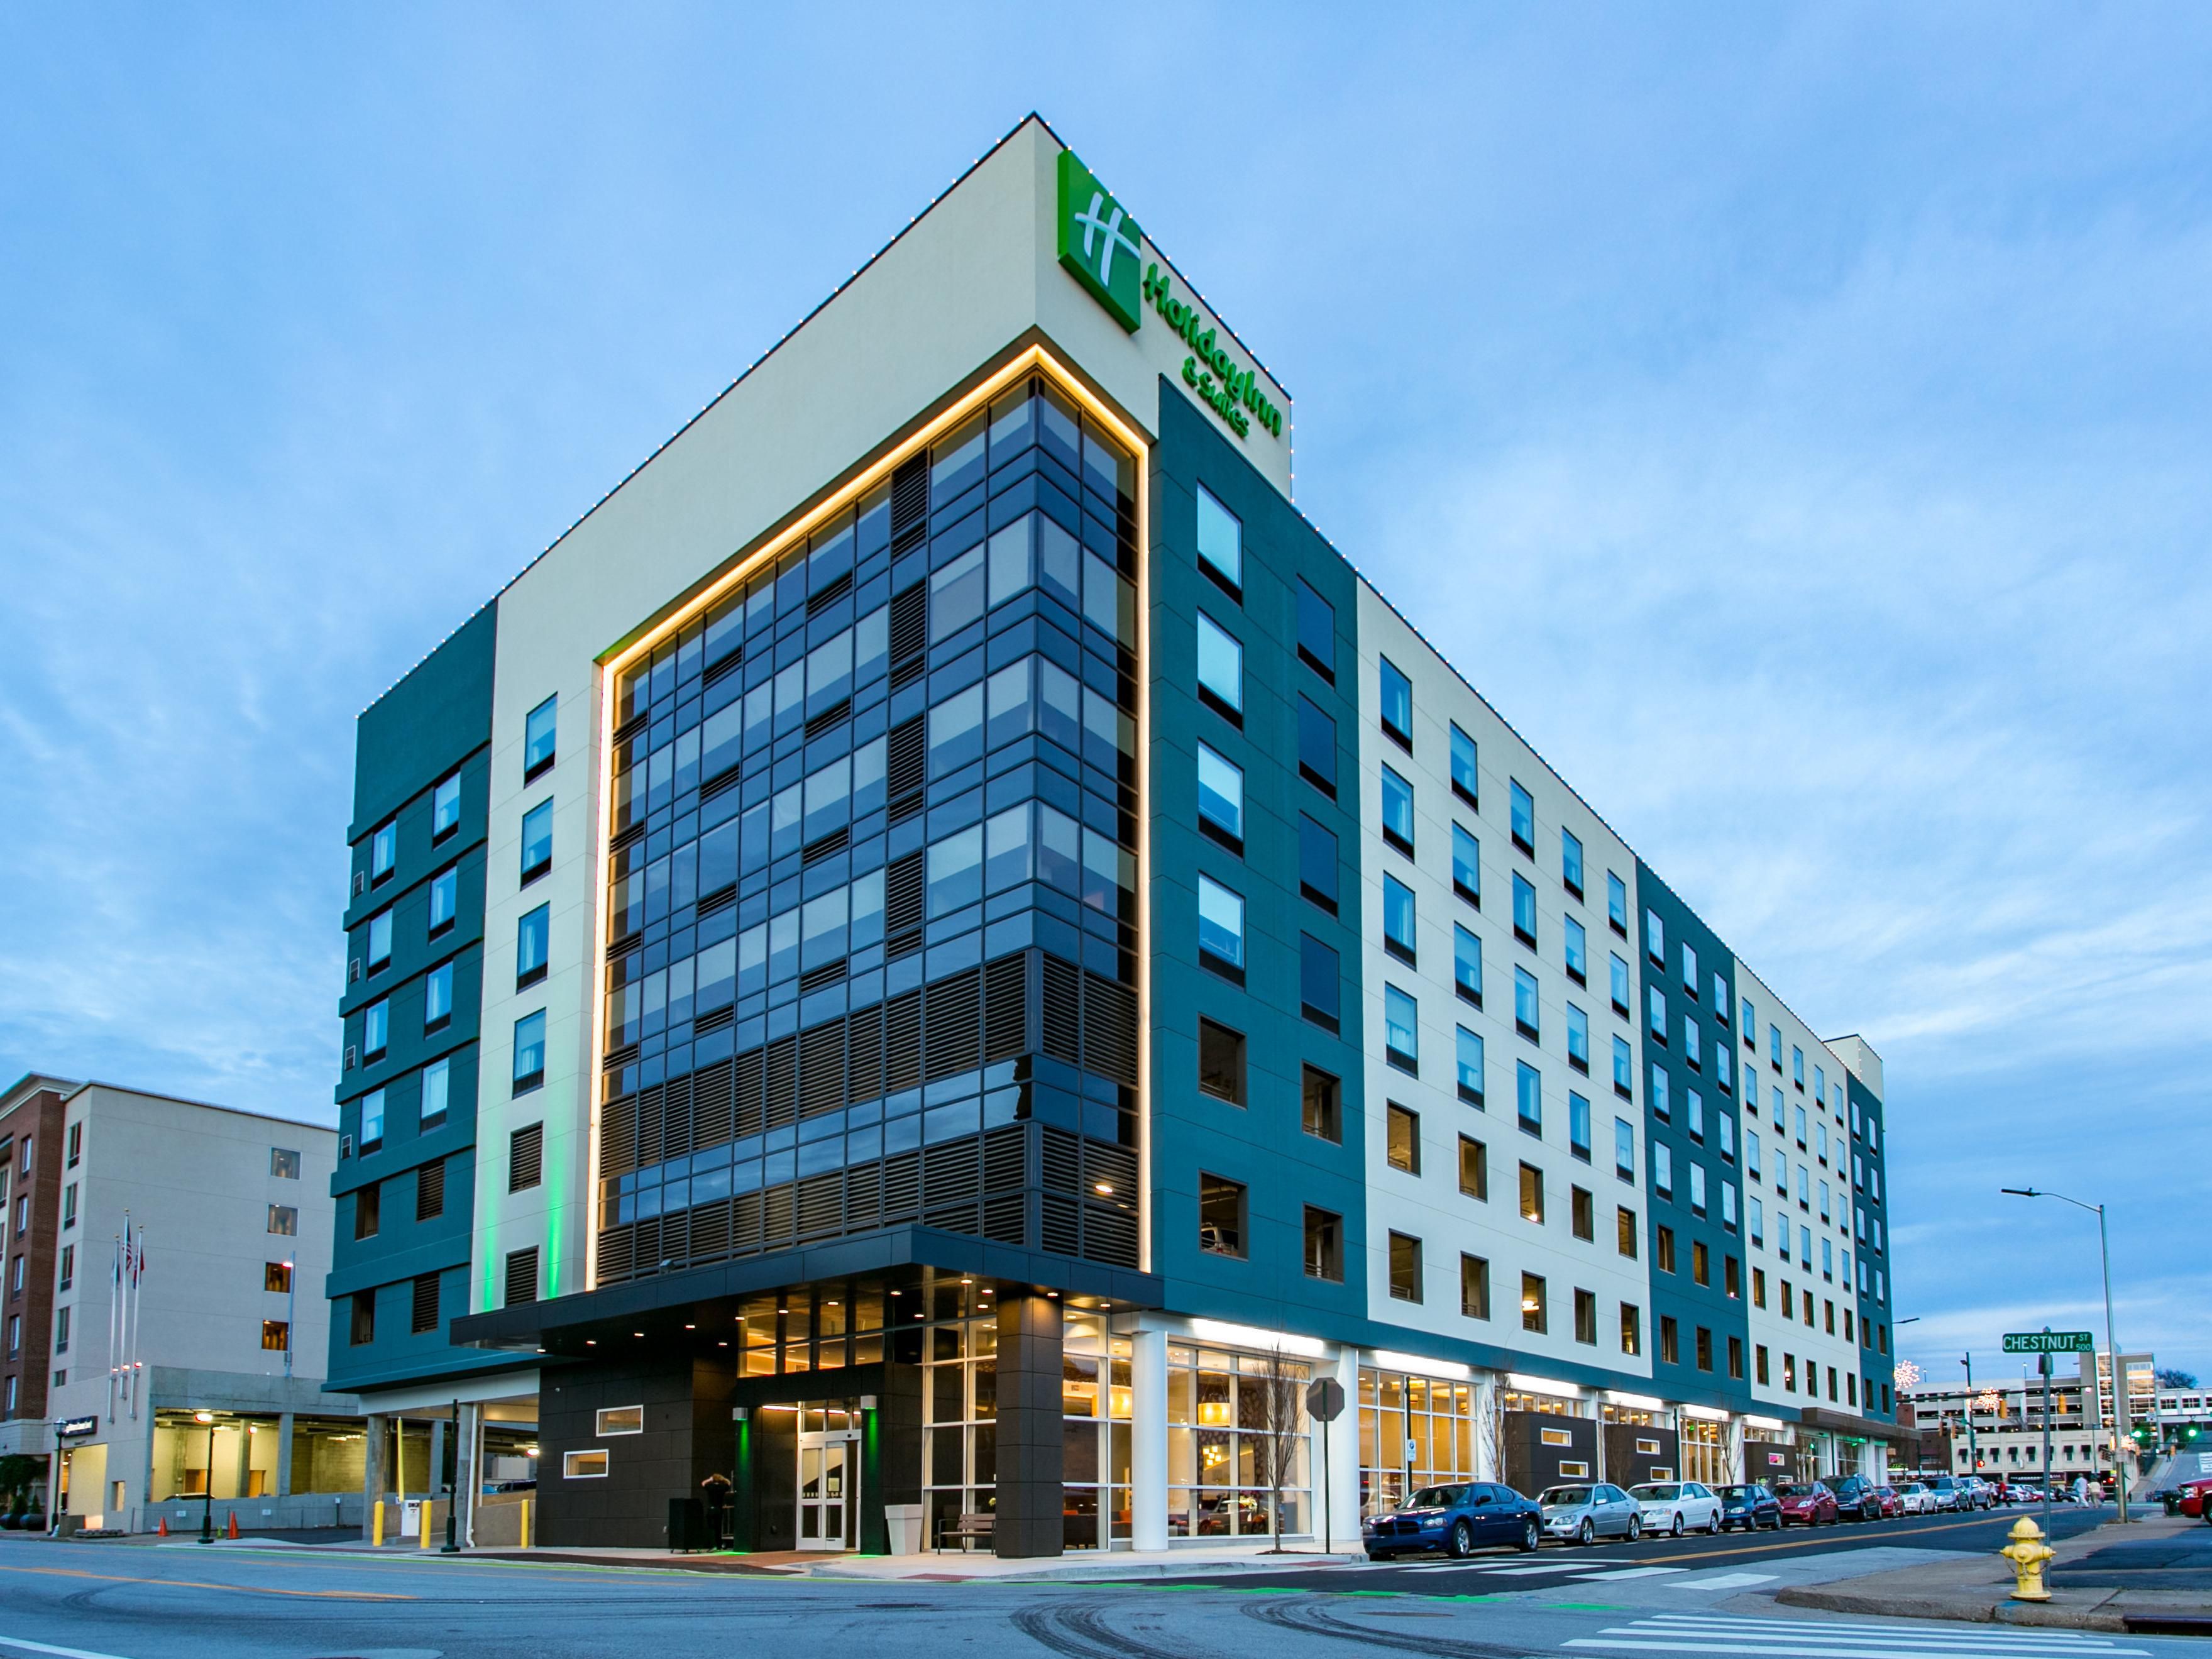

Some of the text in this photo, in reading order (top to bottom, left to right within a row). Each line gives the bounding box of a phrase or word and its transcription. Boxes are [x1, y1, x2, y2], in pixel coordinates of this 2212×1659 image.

[1182, 356, 1249, 438] & Suites
[2003, 1335, 2076, 1350] CHESTNUT
